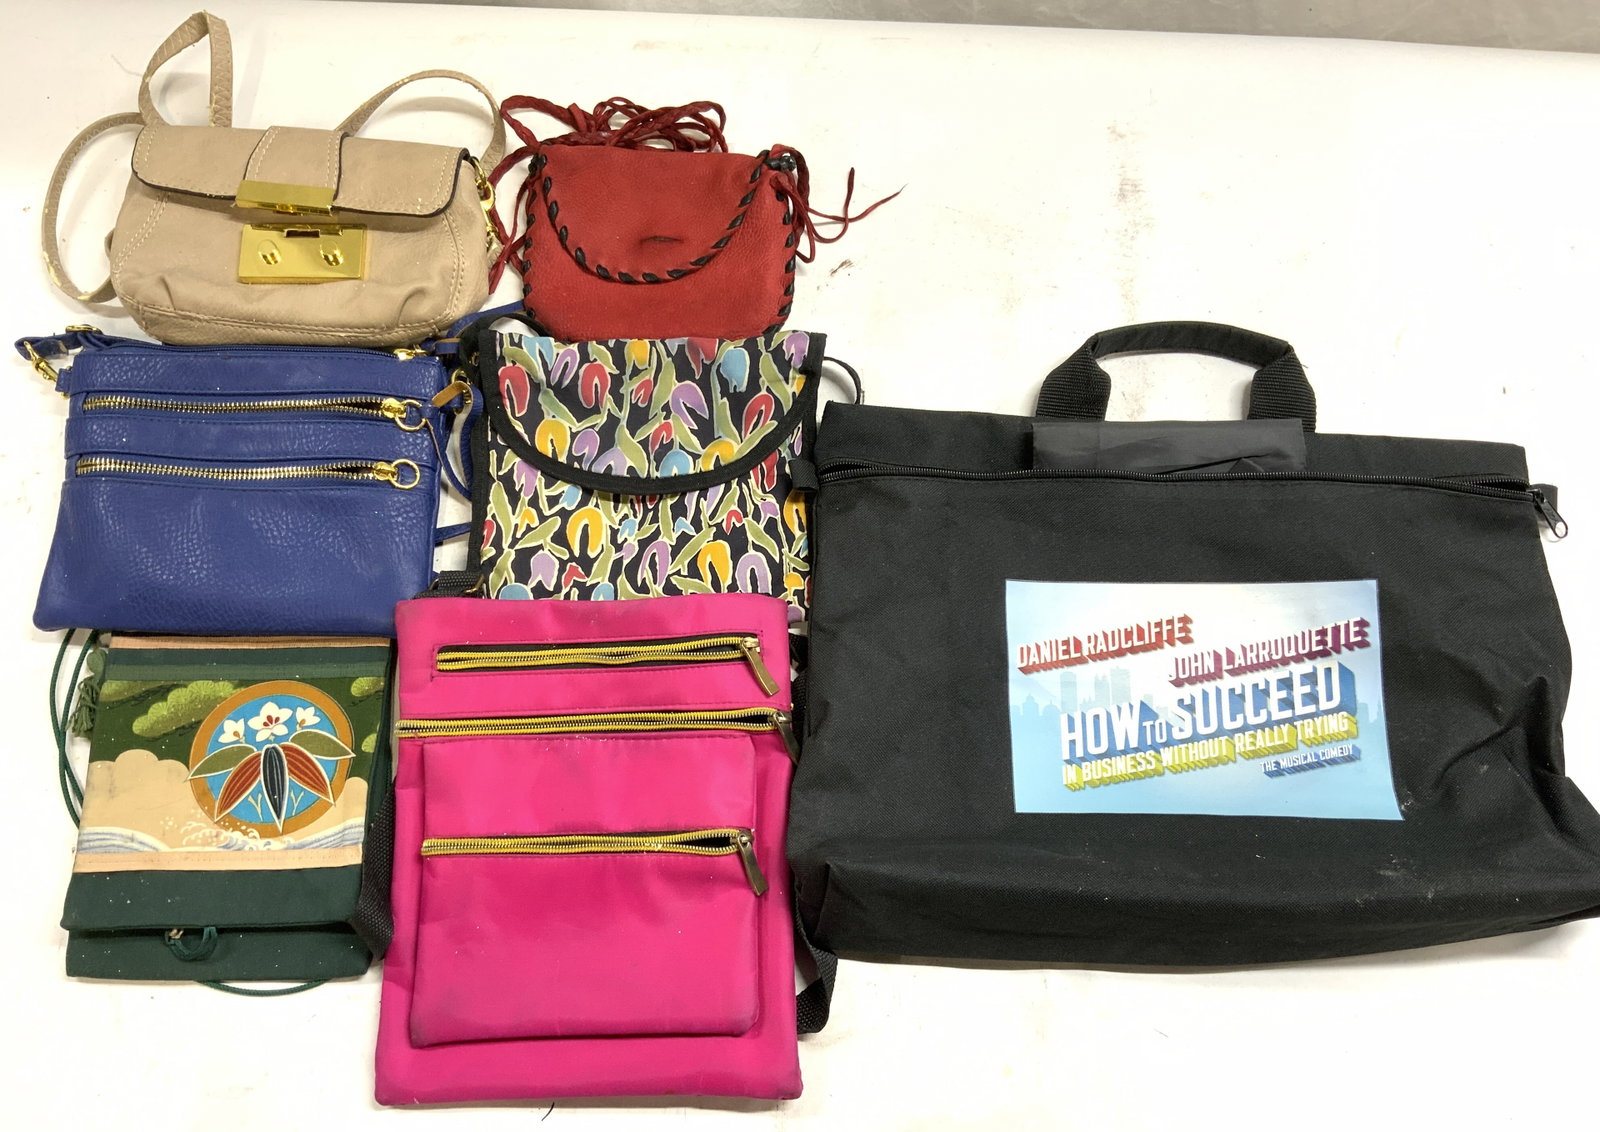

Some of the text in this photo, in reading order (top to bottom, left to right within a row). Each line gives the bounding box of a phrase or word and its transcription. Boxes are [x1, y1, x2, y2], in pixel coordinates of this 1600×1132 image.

[1016, 614, 1191, 671] DANIEL RADCLIFFE
[1168, 653, 1220, 685] JOHN
[1060, 660, 1347, 761] HOW TO SUCCEED
[1062, 712, 1351, 788] IN BUSINESS WITHOUT REALLY TRYING
[1260, 743, 1356, 775] THE MUSICAL COMEDY
